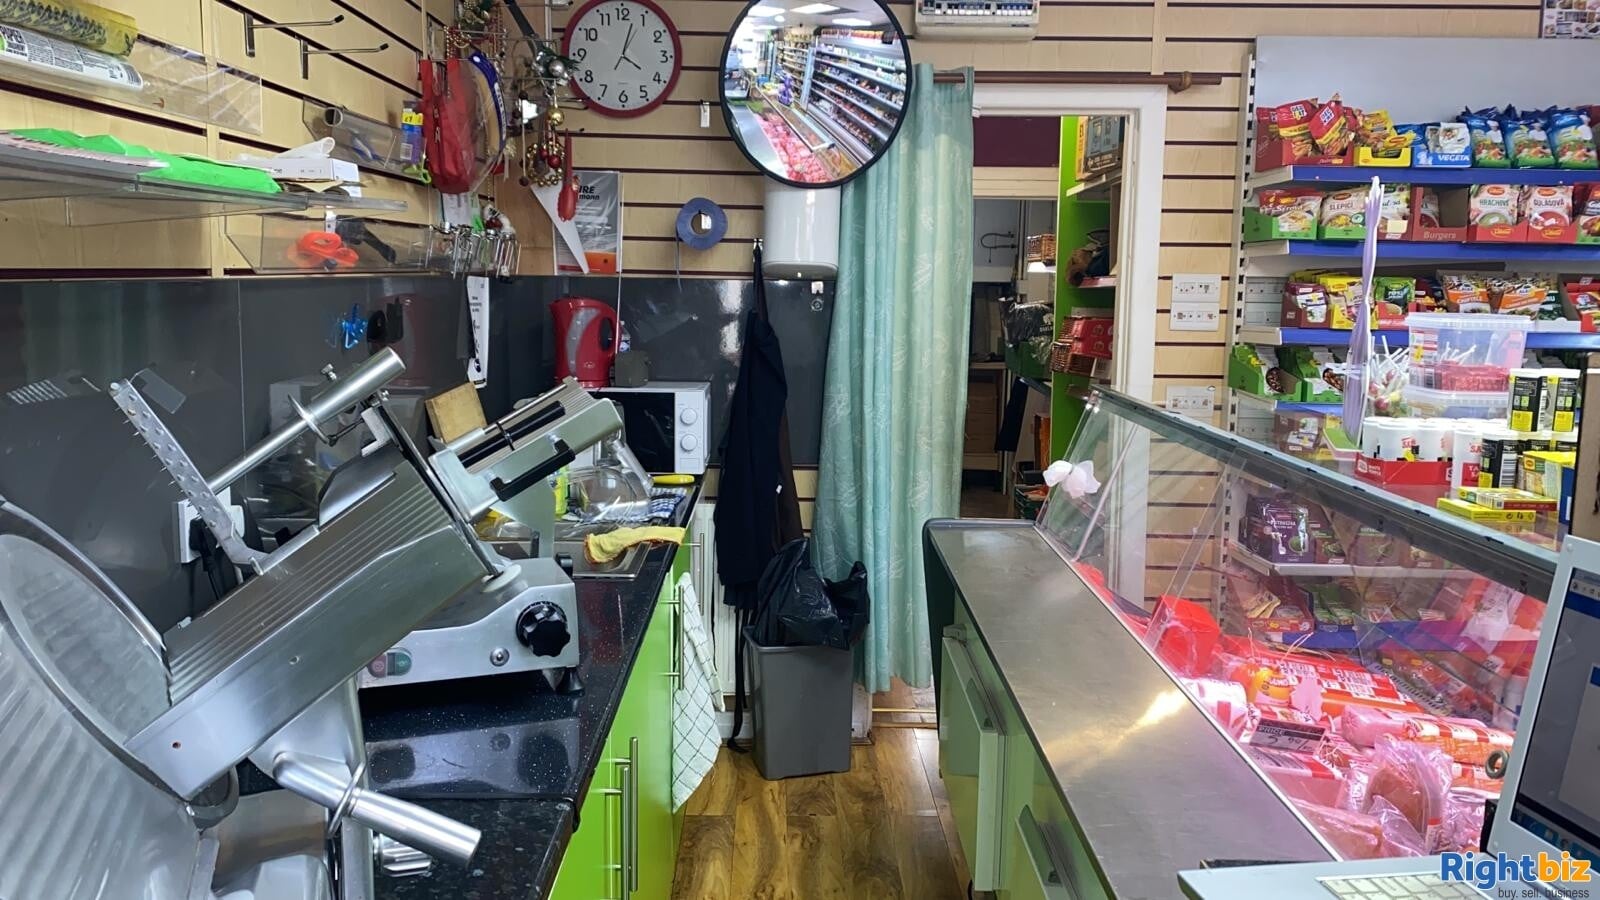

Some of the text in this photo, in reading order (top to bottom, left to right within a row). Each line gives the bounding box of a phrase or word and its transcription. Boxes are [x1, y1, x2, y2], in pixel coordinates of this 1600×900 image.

[600, 13, 610, 26] 11
[615, 8, 630, 20] 12
[584, 28, 598, 41] 10
[653, 30, 662, 43] 2
[577, 48, 587, 61] 9
[660, 50, 668, 63] 3
[584, 70, 594, 83] 8
[653, 72, 662, 84] 4
[600, 84, 608, 97] 7
[618, 90, 628, 103] 6
[640, 85, 648, 98] 5
[579, 185, 595, 194] IRE
[1423, 230, 1456, 240] Burgers
[1258, 725, 1284, 737] PRICE
